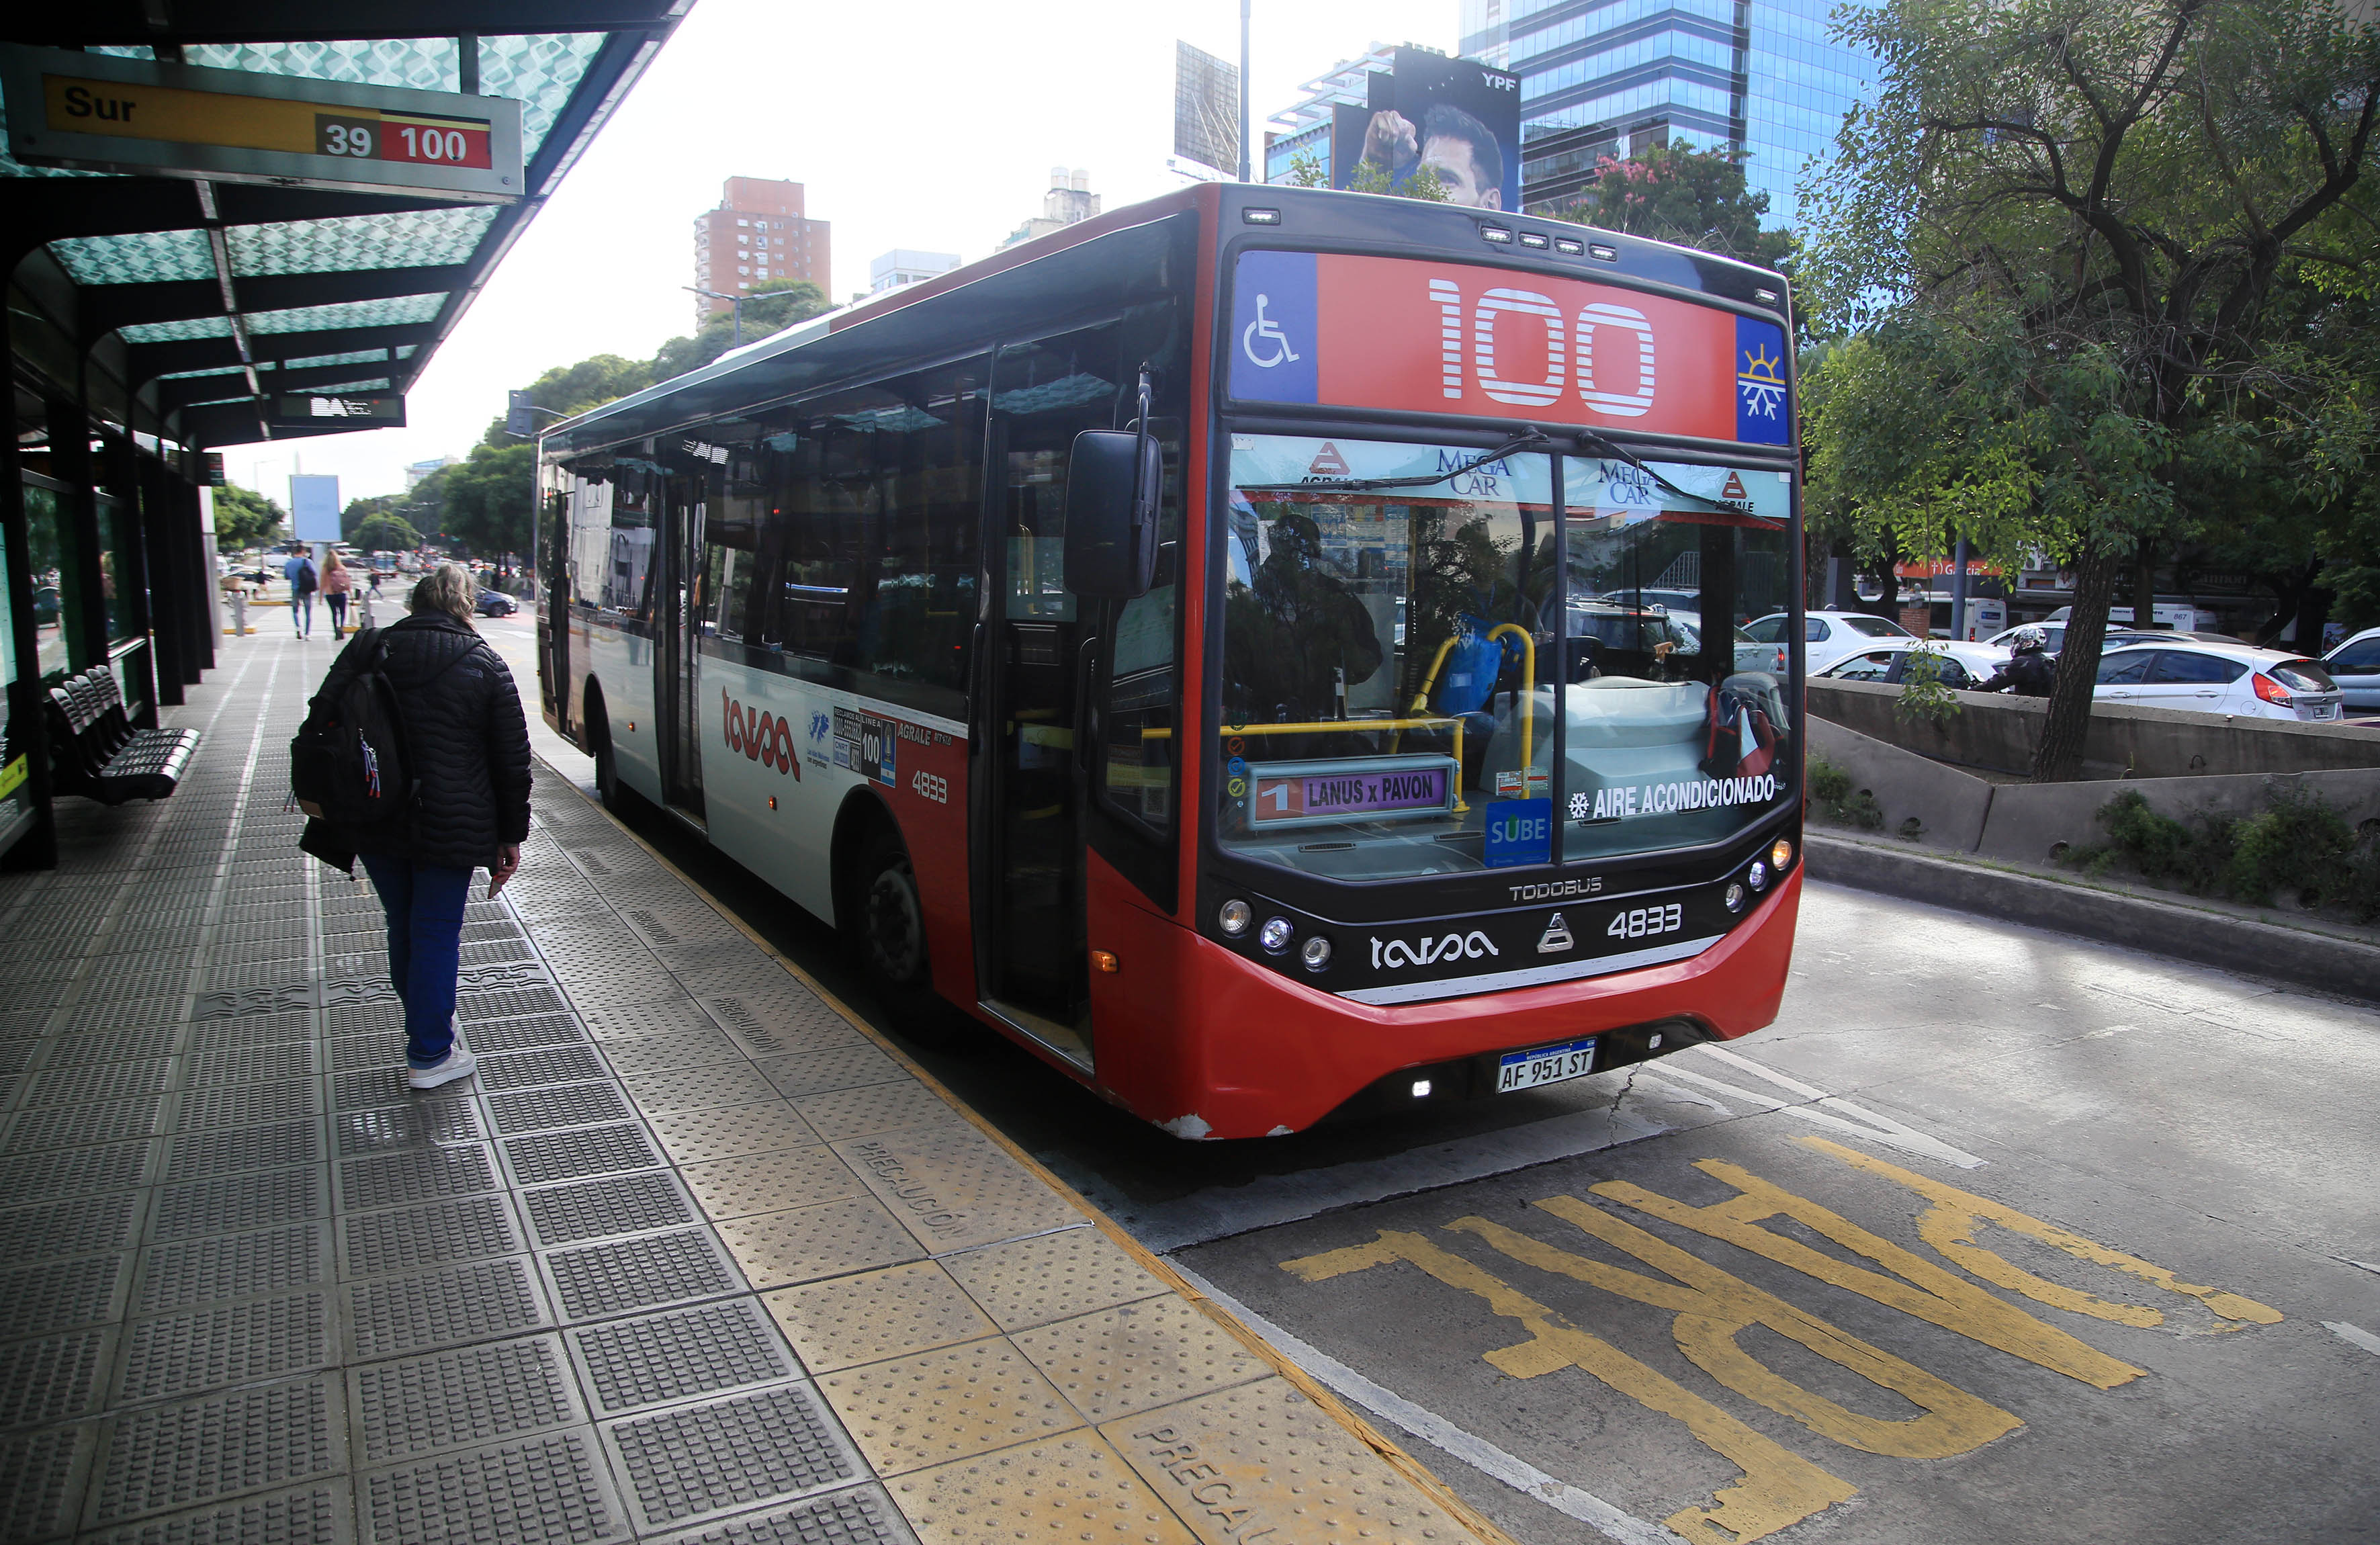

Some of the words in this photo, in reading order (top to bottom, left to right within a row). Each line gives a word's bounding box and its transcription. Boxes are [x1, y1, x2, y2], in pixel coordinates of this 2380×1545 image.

[1482, 72, 1516, 91] YPF
[64, 86, 136, 123] Sur
[326, 124, 372, 158] 39
[400, 127, 467, 162] 100
[1429, 278, 1655, 417] 100
[1436, 449, 1513, 476] MEGA
[1450, 472, 1501, 496] CAR
[1610, 482, 1652, 505] CAR
[862, 717, 881, 728] LINEA
[897, 723, 931, 746] AGRALE
[862, 733, 880, 764] 100
[912, 770, 947, 804] 4833
[1261, 783, 1288, 811] 1
[1309, 779, 1363, 807] LANUS
[1368, 785, 1378, 802] x
[1382, 775, 1433, 801] PAVON
[1593, 786, 1638, 819] AIRE
[1641, 773, 1775, 815] ACONDICIONADO
[1491, 818, 1546, 844] SUBE
[1509, 877, 1602, 901] TODOBUS
[1607, 903, 1682, 940] 4833
[1549, 1047, 1571, 1057] ARGENTINA
[1502, 1064, 1526, 1089] AF
[1531, 1057, 1563, 1084] 951
[1569, 1050, 1591, 1075] ST
[850, 1141, 974, 1241] PRECAUCIÓN
